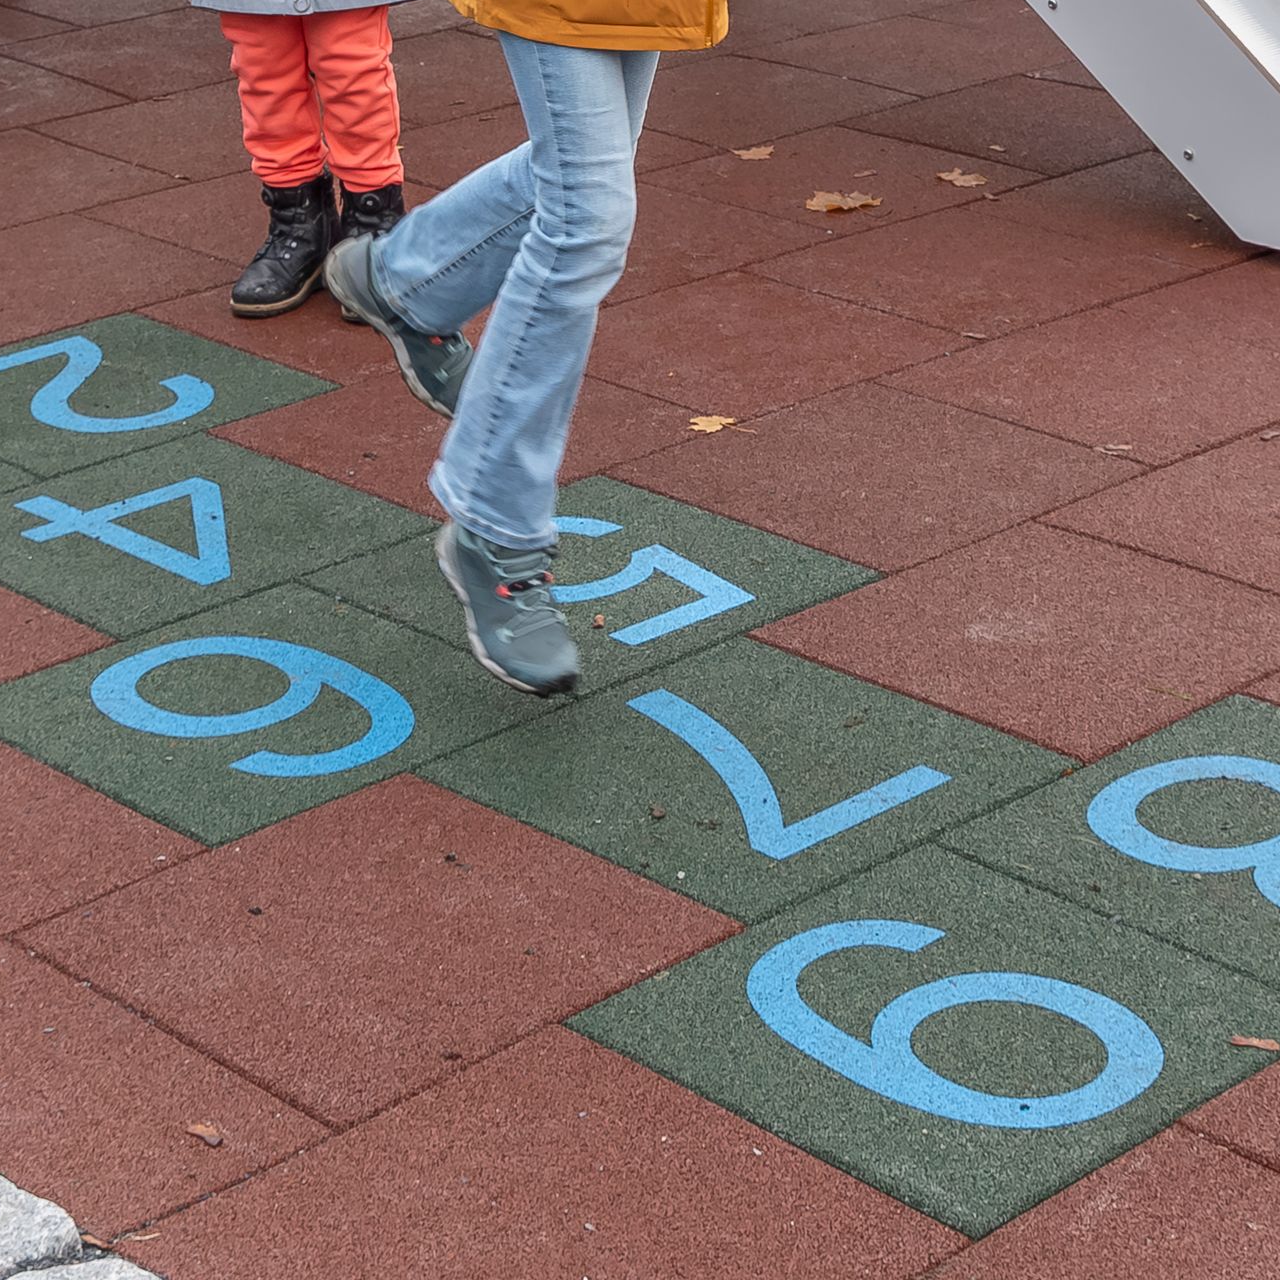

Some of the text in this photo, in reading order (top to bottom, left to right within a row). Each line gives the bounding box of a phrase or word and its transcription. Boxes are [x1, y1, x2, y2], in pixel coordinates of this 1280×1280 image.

[14, 476, 232, 586] 4
[551, 516, 757, 646] 5
[90, 635, 417, 778] 6
[626, 688, 953, 861] 7
[746, 918, 1165, 1130] 9
